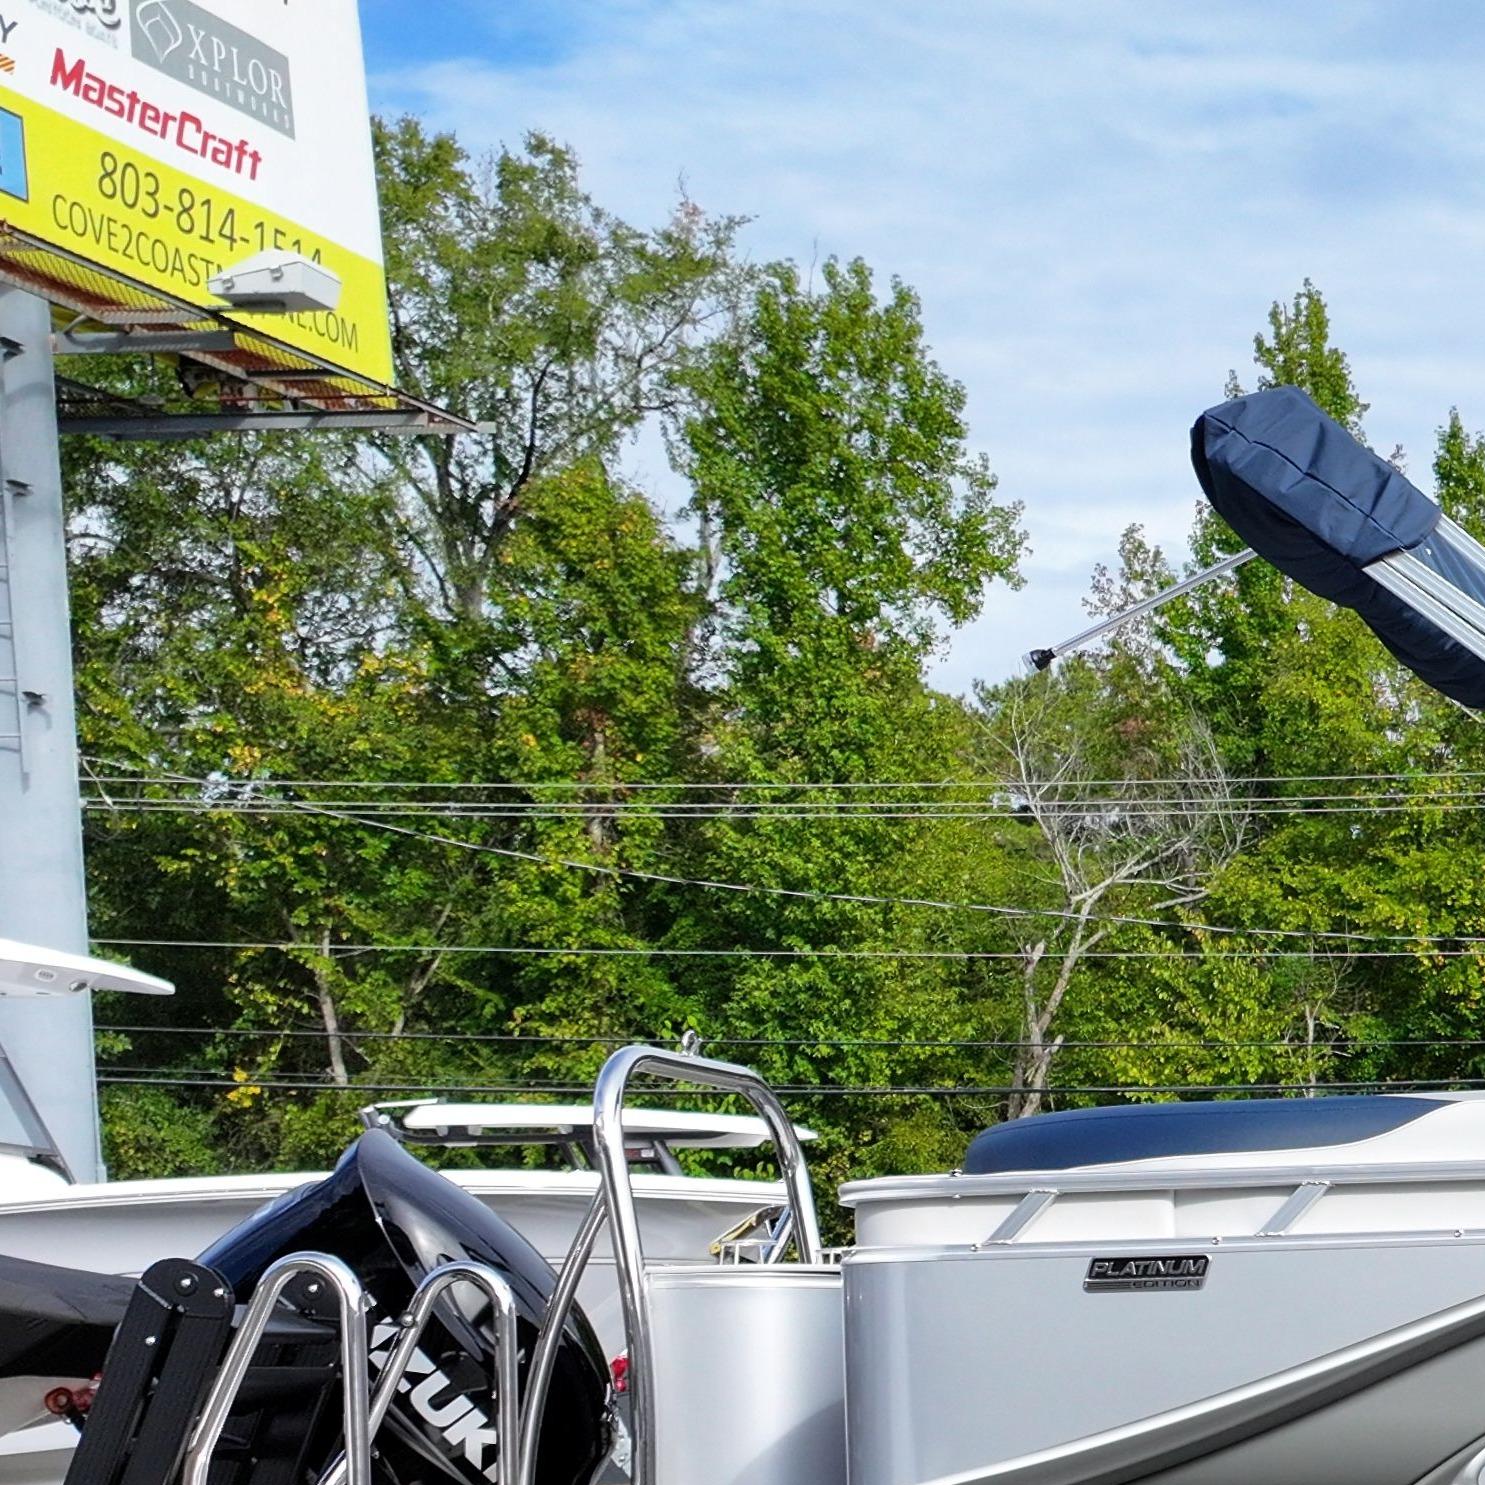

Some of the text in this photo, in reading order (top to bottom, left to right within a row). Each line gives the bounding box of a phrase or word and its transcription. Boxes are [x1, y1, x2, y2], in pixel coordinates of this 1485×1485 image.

[188, 23, 288, 109] XPLOR
[50, 47, 262, 180] MasterCraft
[1093, 1260, 1205, 1277] PLATINUM
[1132, 1279, 1200, 1289] EDITION
